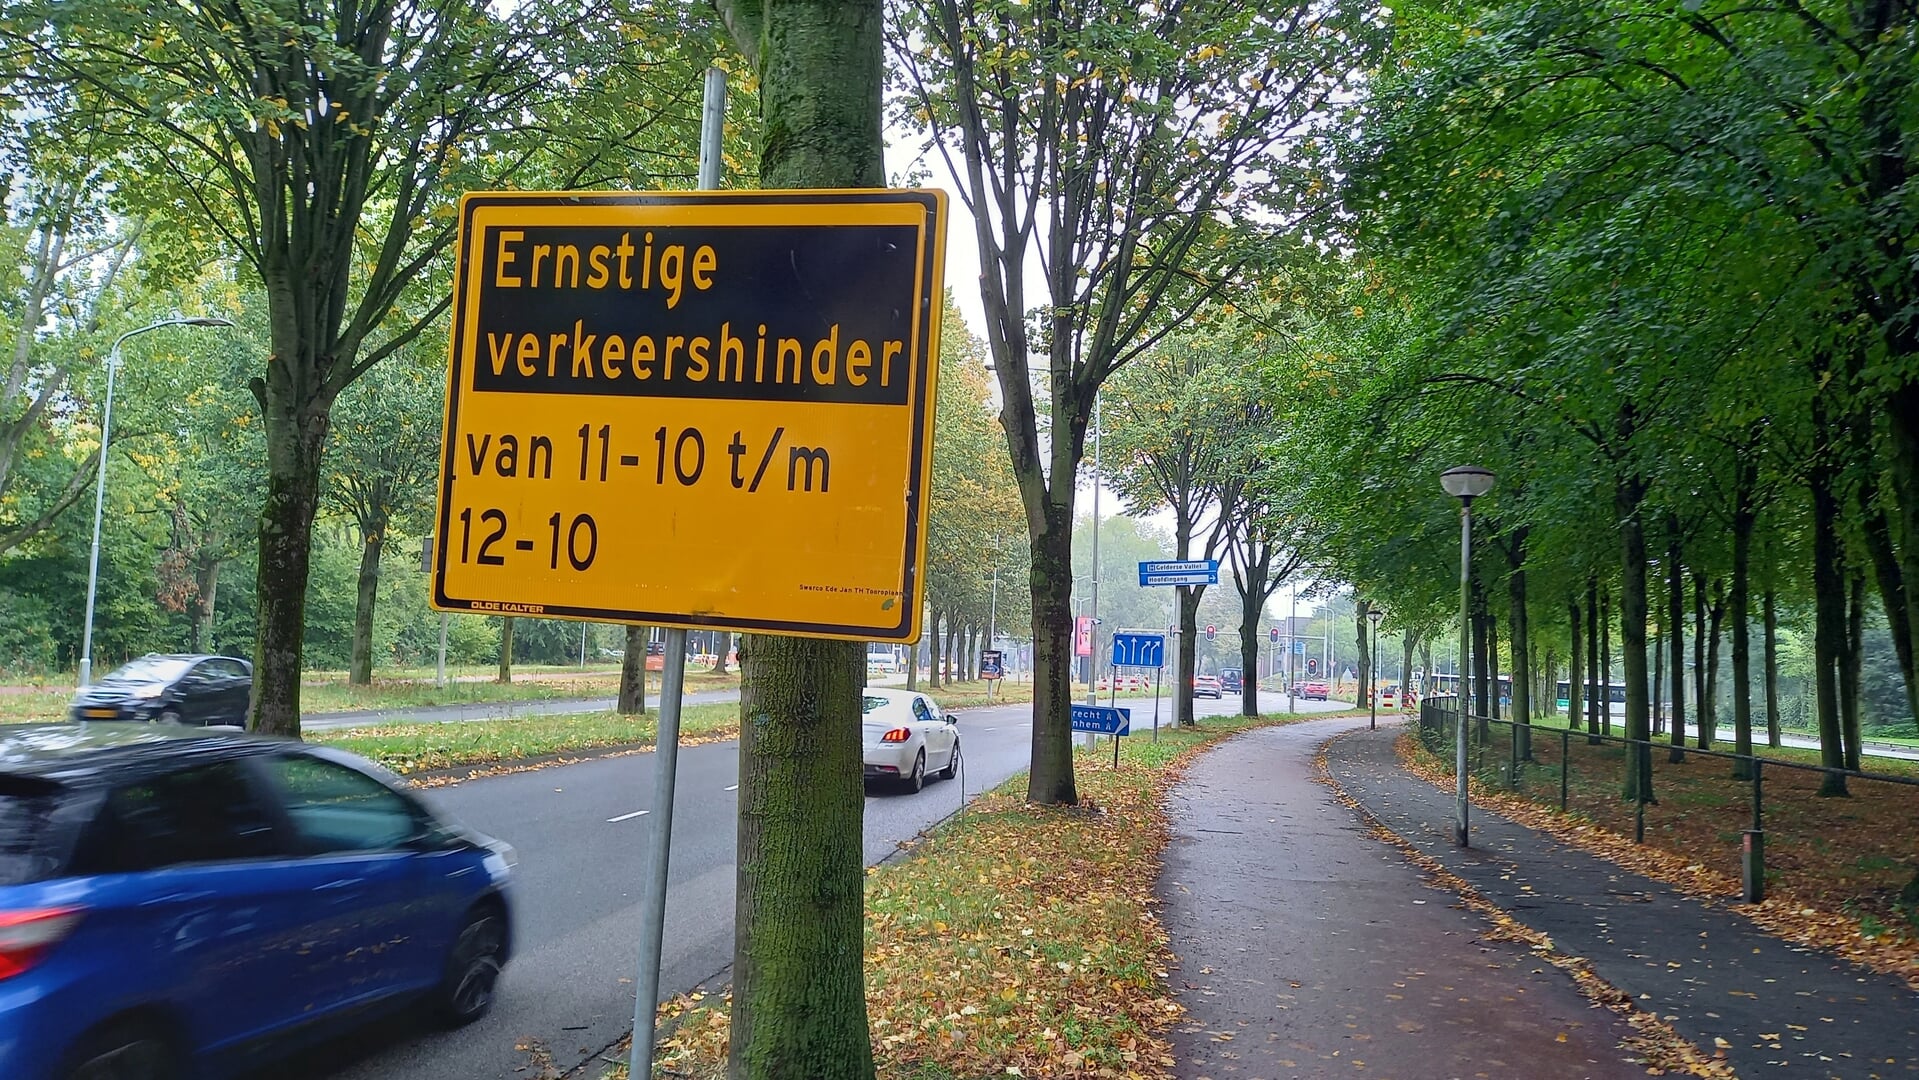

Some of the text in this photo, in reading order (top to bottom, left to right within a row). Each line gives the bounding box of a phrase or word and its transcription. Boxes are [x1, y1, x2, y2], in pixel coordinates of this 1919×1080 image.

[495, 231, 718, 309] Ernstige
[487, 319, 902, 387] verkeershinder
[465, 423, 831, 493] van 11-10 t/m
[459, 507, 598, 572] 12-10
[1156, 563, 1183, 571] Gelderse
[799, 584, 823, 592] Swarco
[471, 601, 544, 613] OLDE KALTER
[1072, 710, 1101, 719] recht
[1072, 719, 1101, 729] nhem
